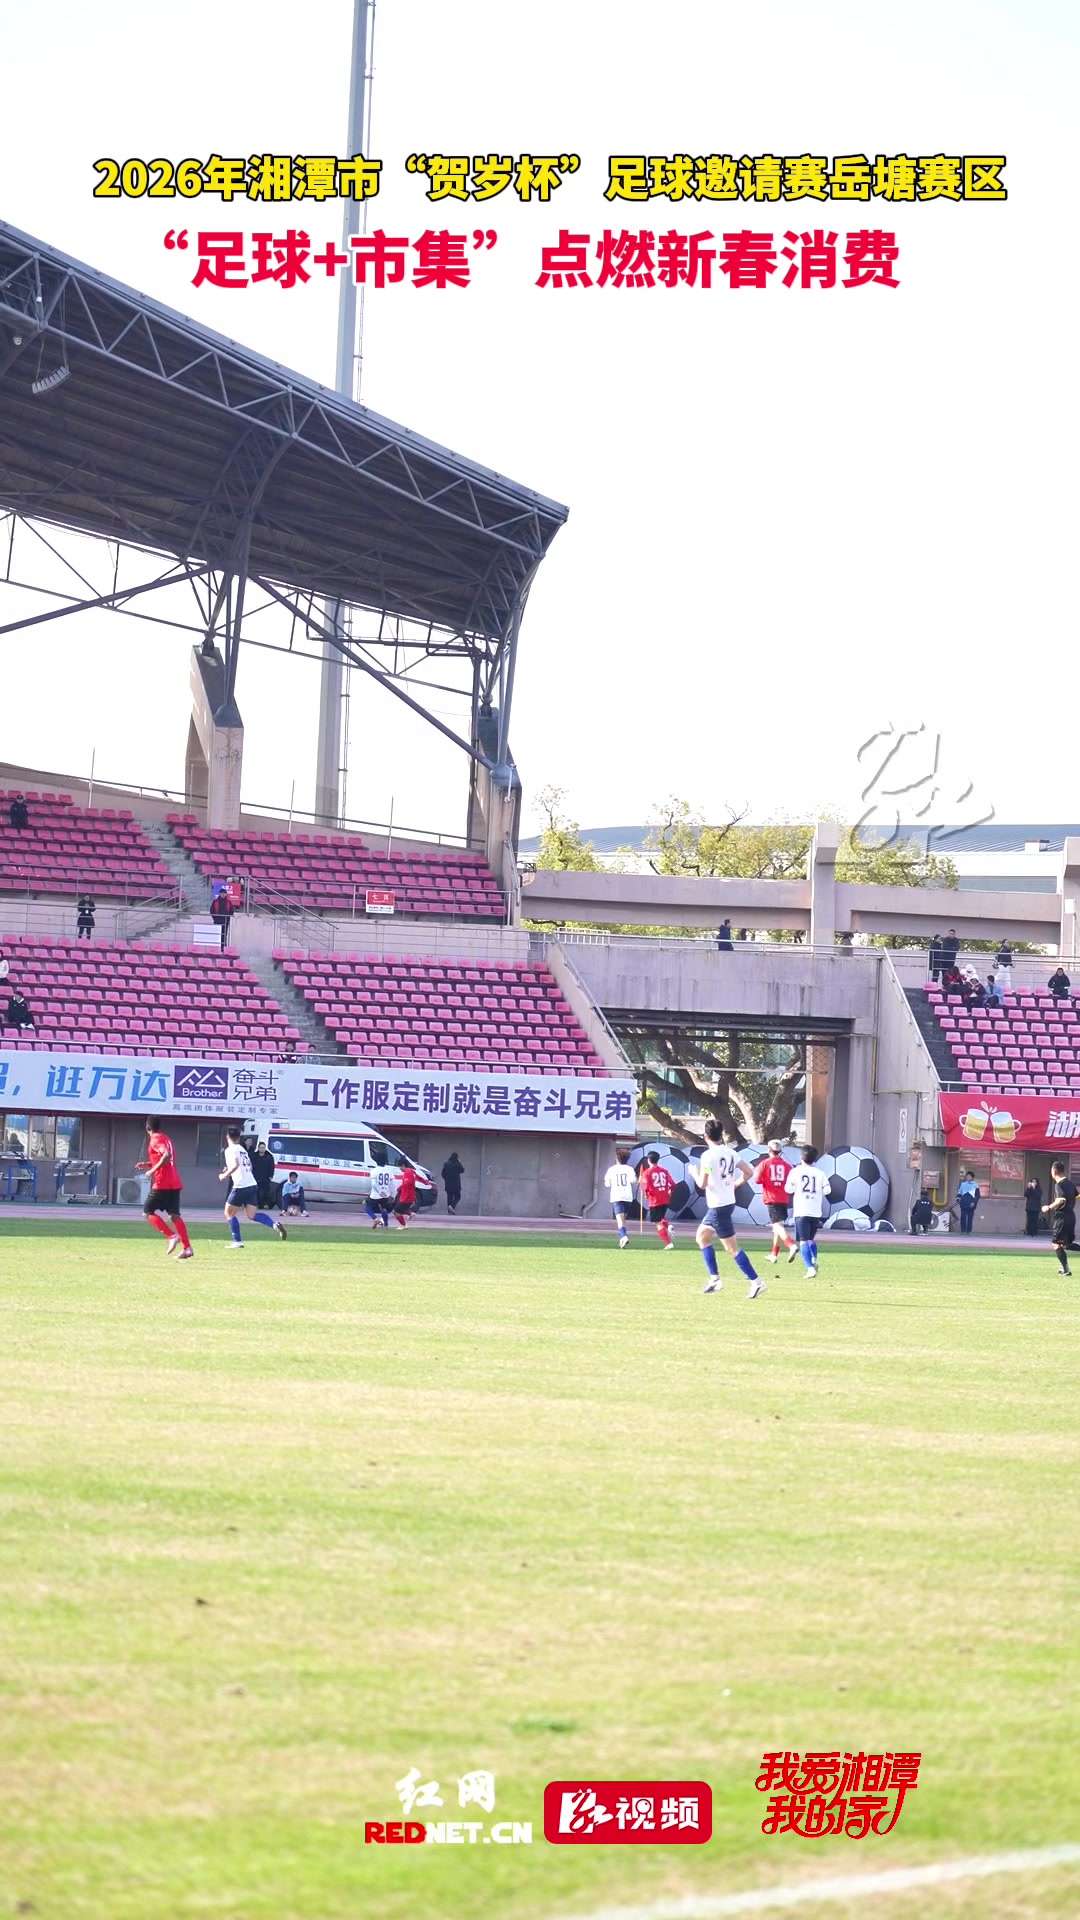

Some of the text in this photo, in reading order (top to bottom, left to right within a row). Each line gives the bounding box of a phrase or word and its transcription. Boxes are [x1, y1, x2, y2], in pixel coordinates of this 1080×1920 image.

[182, 1087, 223, 1098] Brother
[301, 1077, 633, 1120] 工作服定制就是奋斗兄弟
[719, 1156, 735, 1179] 24
[769, 1164, 786, 1181] 19
[378, 1173, 390, 1186] 98
[616, 1173, 628, 1187] 10
[801, 1175, 817, 1193] 21
